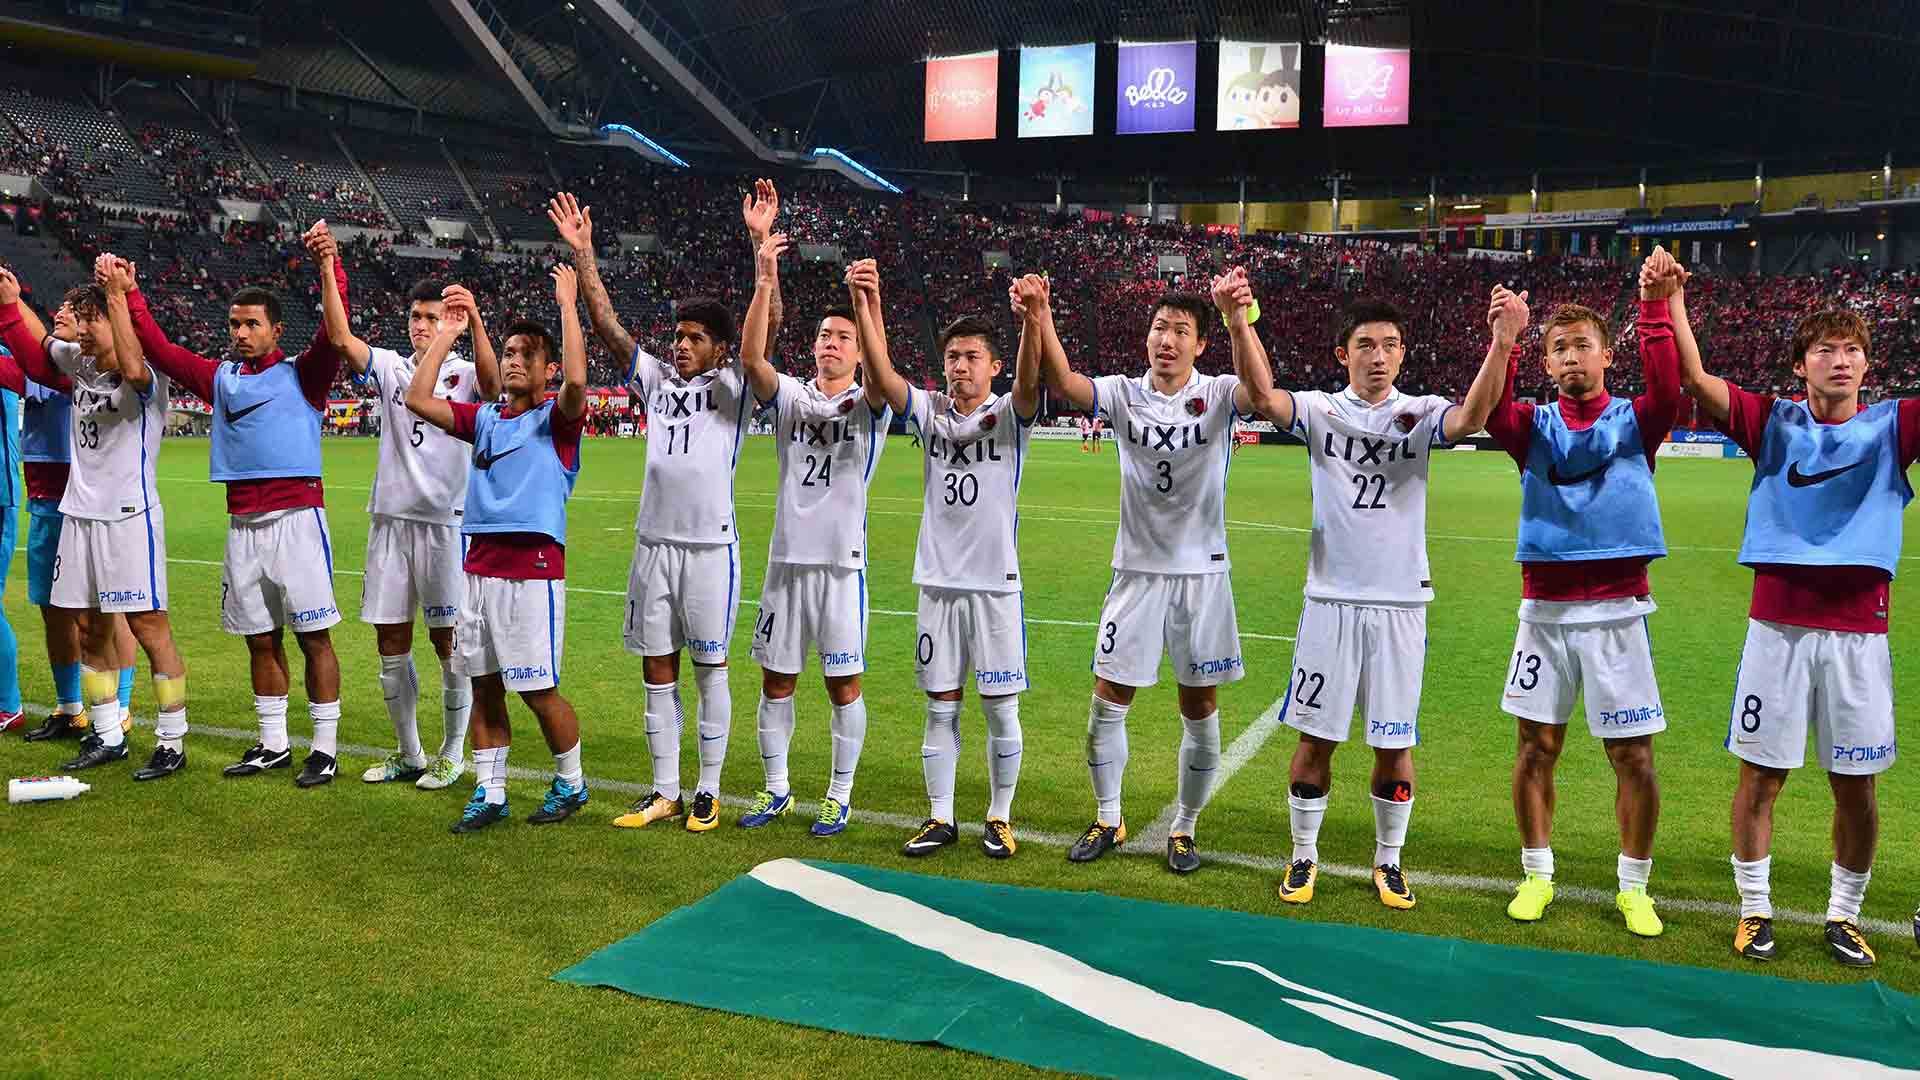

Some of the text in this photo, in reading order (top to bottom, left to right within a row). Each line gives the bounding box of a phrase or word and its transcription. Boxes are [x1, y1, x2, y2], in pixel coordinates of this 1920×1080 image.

[79, 420, 98, 449] 33
[411, 421, 424, 448] 5
[667, 423, 690, 455] 11
[791, 420, 855, 446] LIXIL
[1128, 421, 1208, 451] LIXIL
[1324, 432, 1416, 465] LIXIL
[930, 434, 1001, 465] LIXIL
[802, 454, 832, 487] 24
[1156, 460, 1173, 494] 3
[944, 472, 978, 506] 30
[1352, 473, 1386, 509] 22
[99, 590, 145, 602] アイフルホーム
[915, 632, 933, 665] 0
[1101, 621, 1117, 654] 3
[976, 668, 1023, 683] アイフルホーム
[1189, 656, 1241, 675] アイフルホーム
[1510, 650, 1542, 690] 13
[1295, 667, 1325, 709] 22
[1600, 704, 1663, 725] アイフルホーム
[1741, 694, 1762, 733] 8
[1833, 744, 1896, 761] アイフルホー
